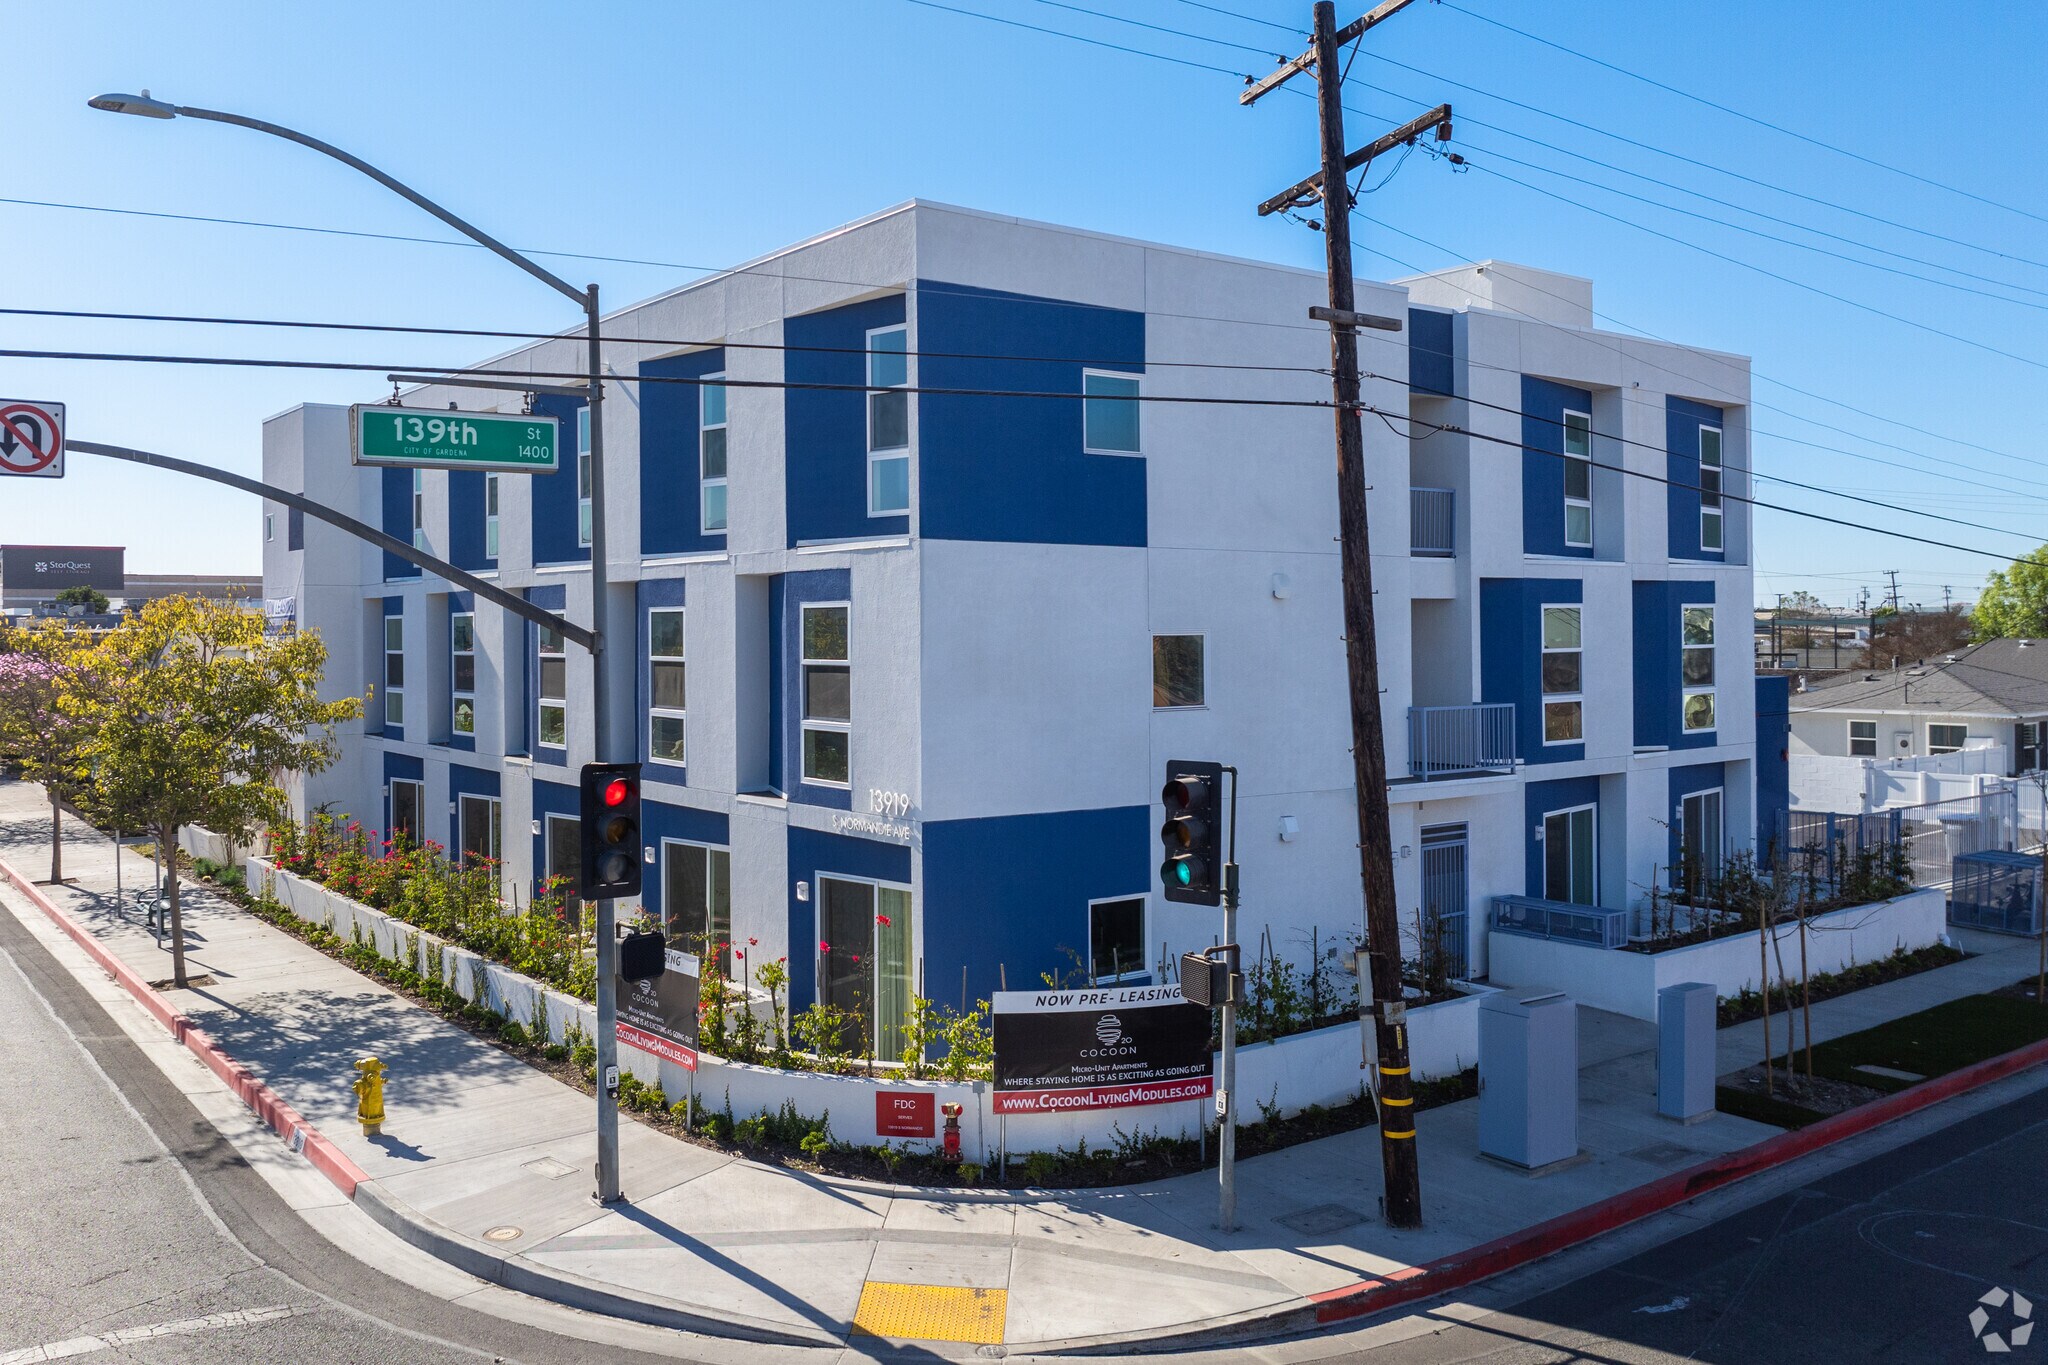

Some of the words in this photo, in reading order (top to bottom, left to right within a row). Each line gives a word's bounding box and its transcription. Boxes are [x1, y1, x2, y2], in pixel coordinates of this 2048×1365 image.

[393, 417, 478, 445] 139th
[527, 427, 541, 440] St
[404, 447, 418, 455] CITY
[436, 448, 468, 456] GARDENA
[518, 445, 549, 459] 1400
[50, 561, 91, 570] StorQuest
[869, 788, 909, 816] 13919
[840, 816, 892, 836] NORMANDIE
[893, 825, 910, 840] AVE
[632, 992, 659, 1008] COCOON
[1035, 994, 1074, 1007] NOW
[1079, 993, 1114, 1005] PRE-
[1120, 987, 1181, 1003] LEASING
[616, 1025, 693, 1067] COCOONLIVINGMODULES.COM
[684, 1035, 694, 1045] OUT
[1080, 1046, 1137, 1058] COCOON
[1004, 1078, 1033, 1086] WHERE
[1035, 1076, 1070, 1085] STAYING
[1072, 1075, 1095, 1083] HOME
[1106, 1073, 1117, 1081] AS
[1118, 1070, 1154, 1080] EXCITING
[1155, 1069, 1165, 1077] AS
[1166, 1066, 1189, 1075] GOING
[1191, 1064, 1206, 1073] OUT
[894, 1100, 916, 1109] FDC
